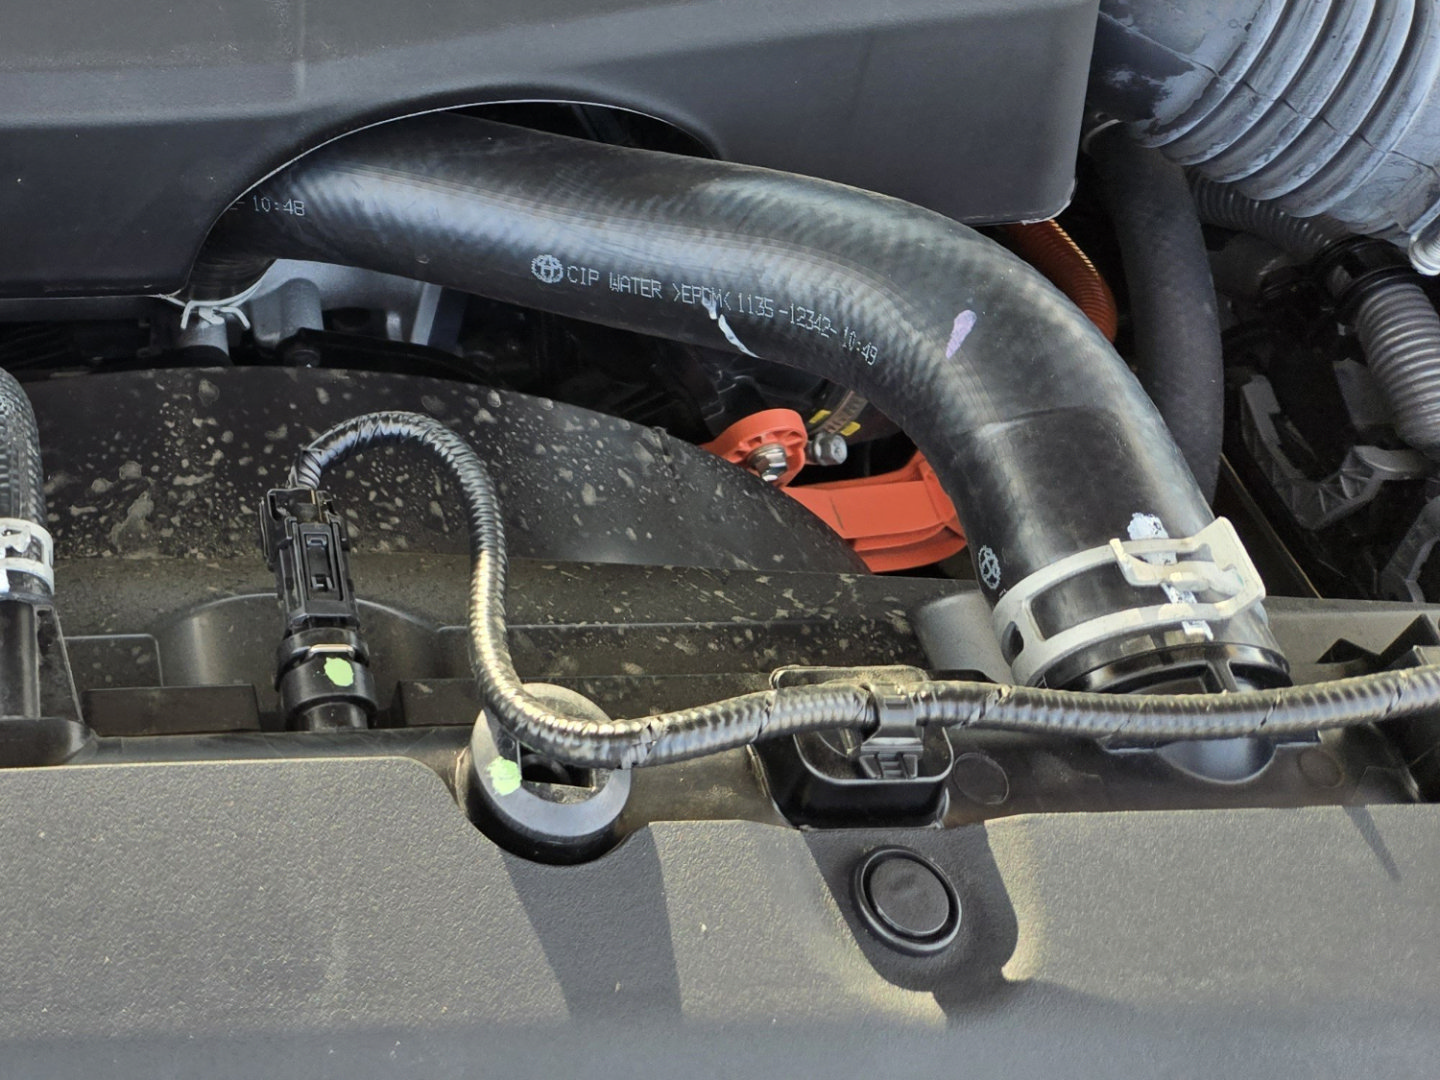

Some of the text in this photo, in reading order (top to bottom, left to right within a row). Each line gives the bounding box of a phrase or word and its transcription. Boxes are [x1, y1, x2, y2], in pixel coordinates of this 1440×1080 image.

[252, 195, 305, 216] 10:48
[568, 265, 599, 287] CIP
[610, 273, 663, 299] WATER
[738, 293, 774, 318] 1135
